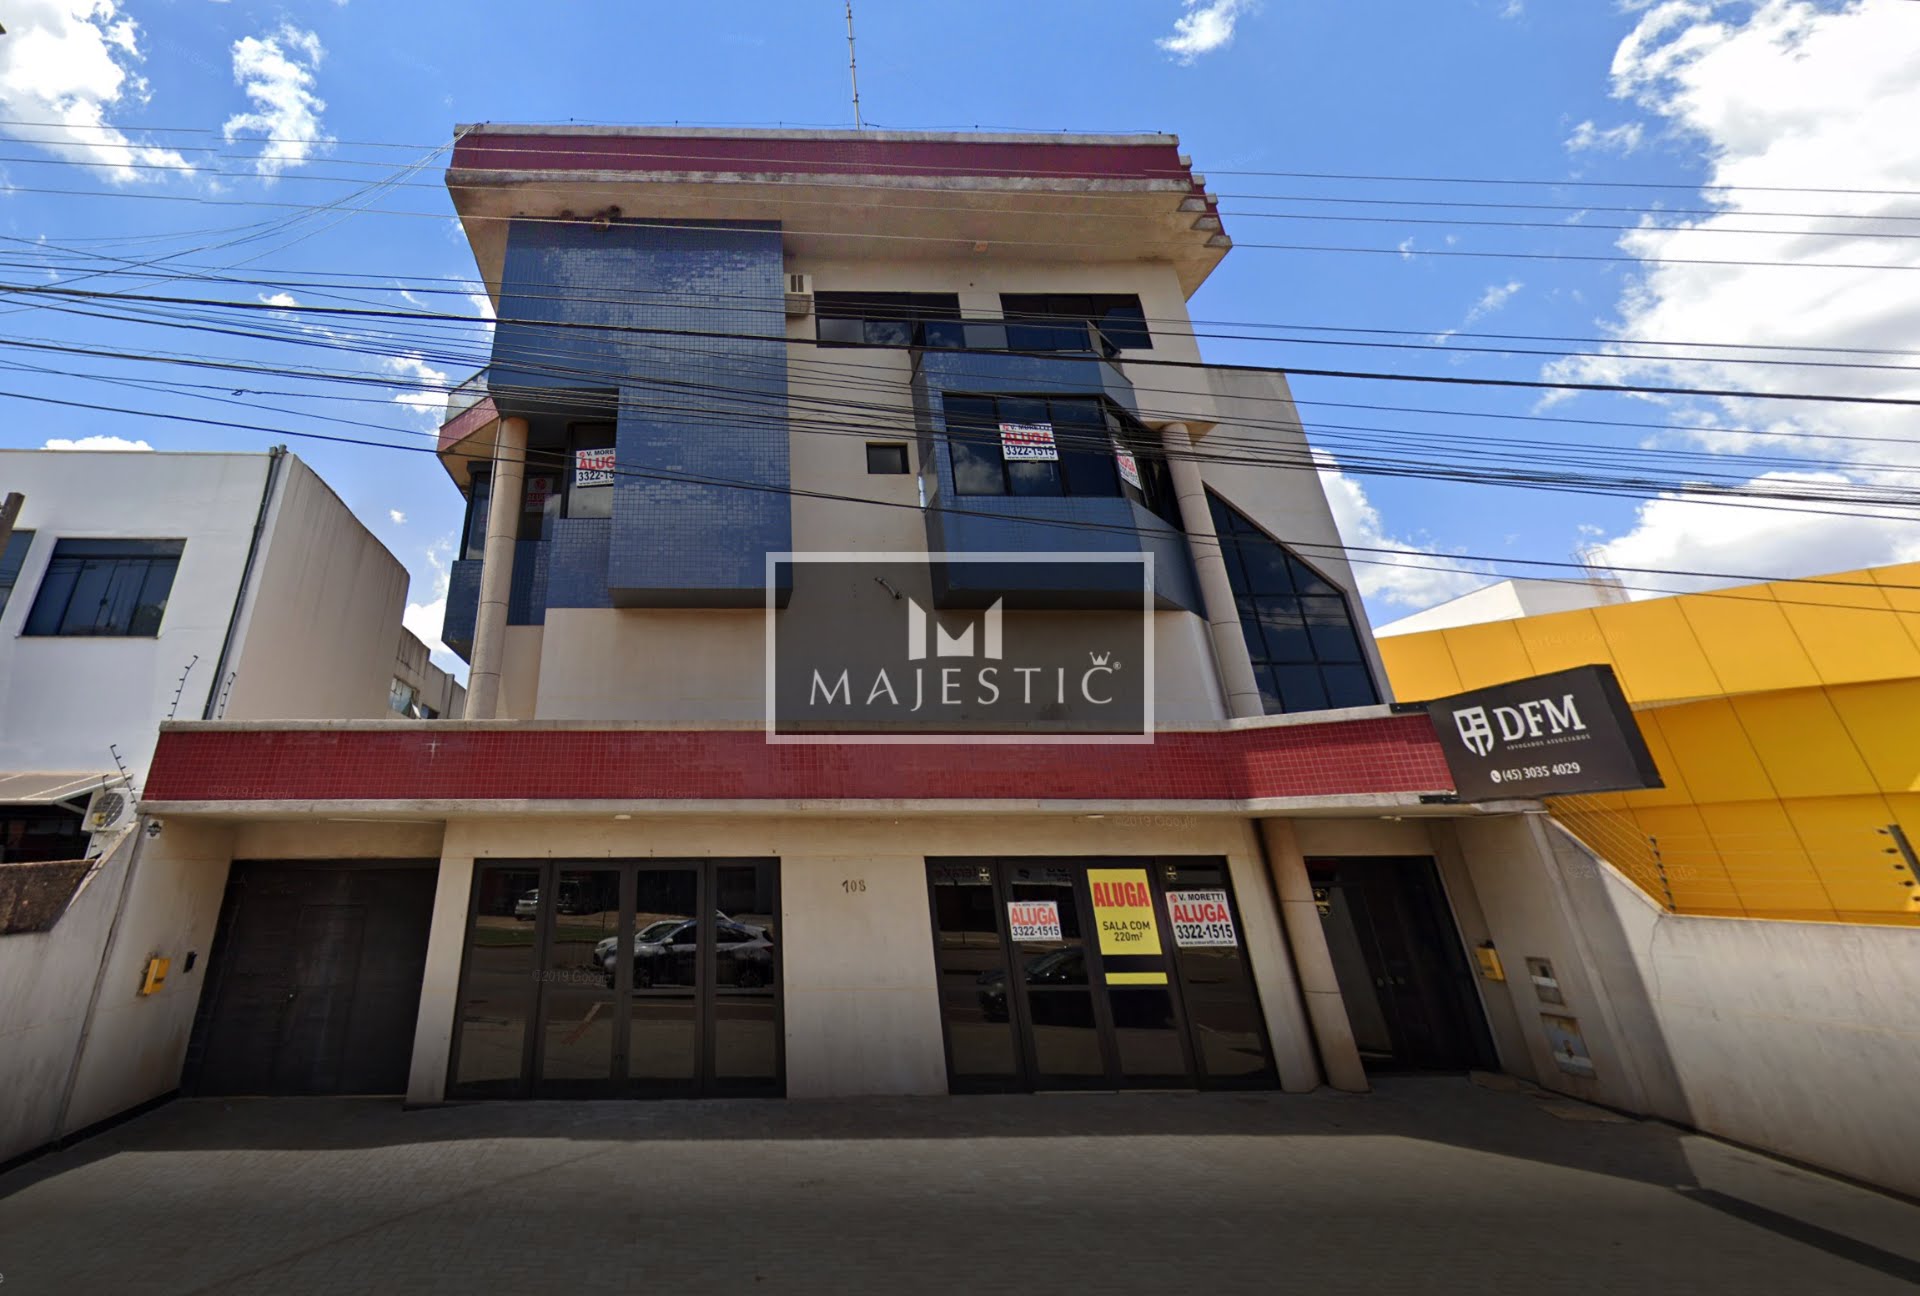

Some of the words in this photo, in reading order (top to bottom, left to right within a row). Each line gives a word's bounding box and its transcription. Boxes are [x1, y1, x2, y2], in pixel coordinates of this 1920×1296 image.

[1004, 432, 1053, 445] ALUGA
[1005, 445, 1055, 456] 3322-1515
[1492, 694, 1587, 741] DFM
[1502, 769, 1522, 783] (45)
[1524, 766, 1549, 780] 3035
[1552, 761, 1581, 776] 4029
[1092, 882, 1150, 907] ALUGA
[1188, 893, 1224, 901] MORETTI
[1011, 906, 1059, 926] ALUGA
[1173, 903, 1229, 923] ALUGA
[1012, 926, 1060, 936] 3322-1515
[1103, 920, 1128, 931] SALA
[1130, 920, 1151, 931] COM
[1176, 924, 1233, 939] 3322-1515
